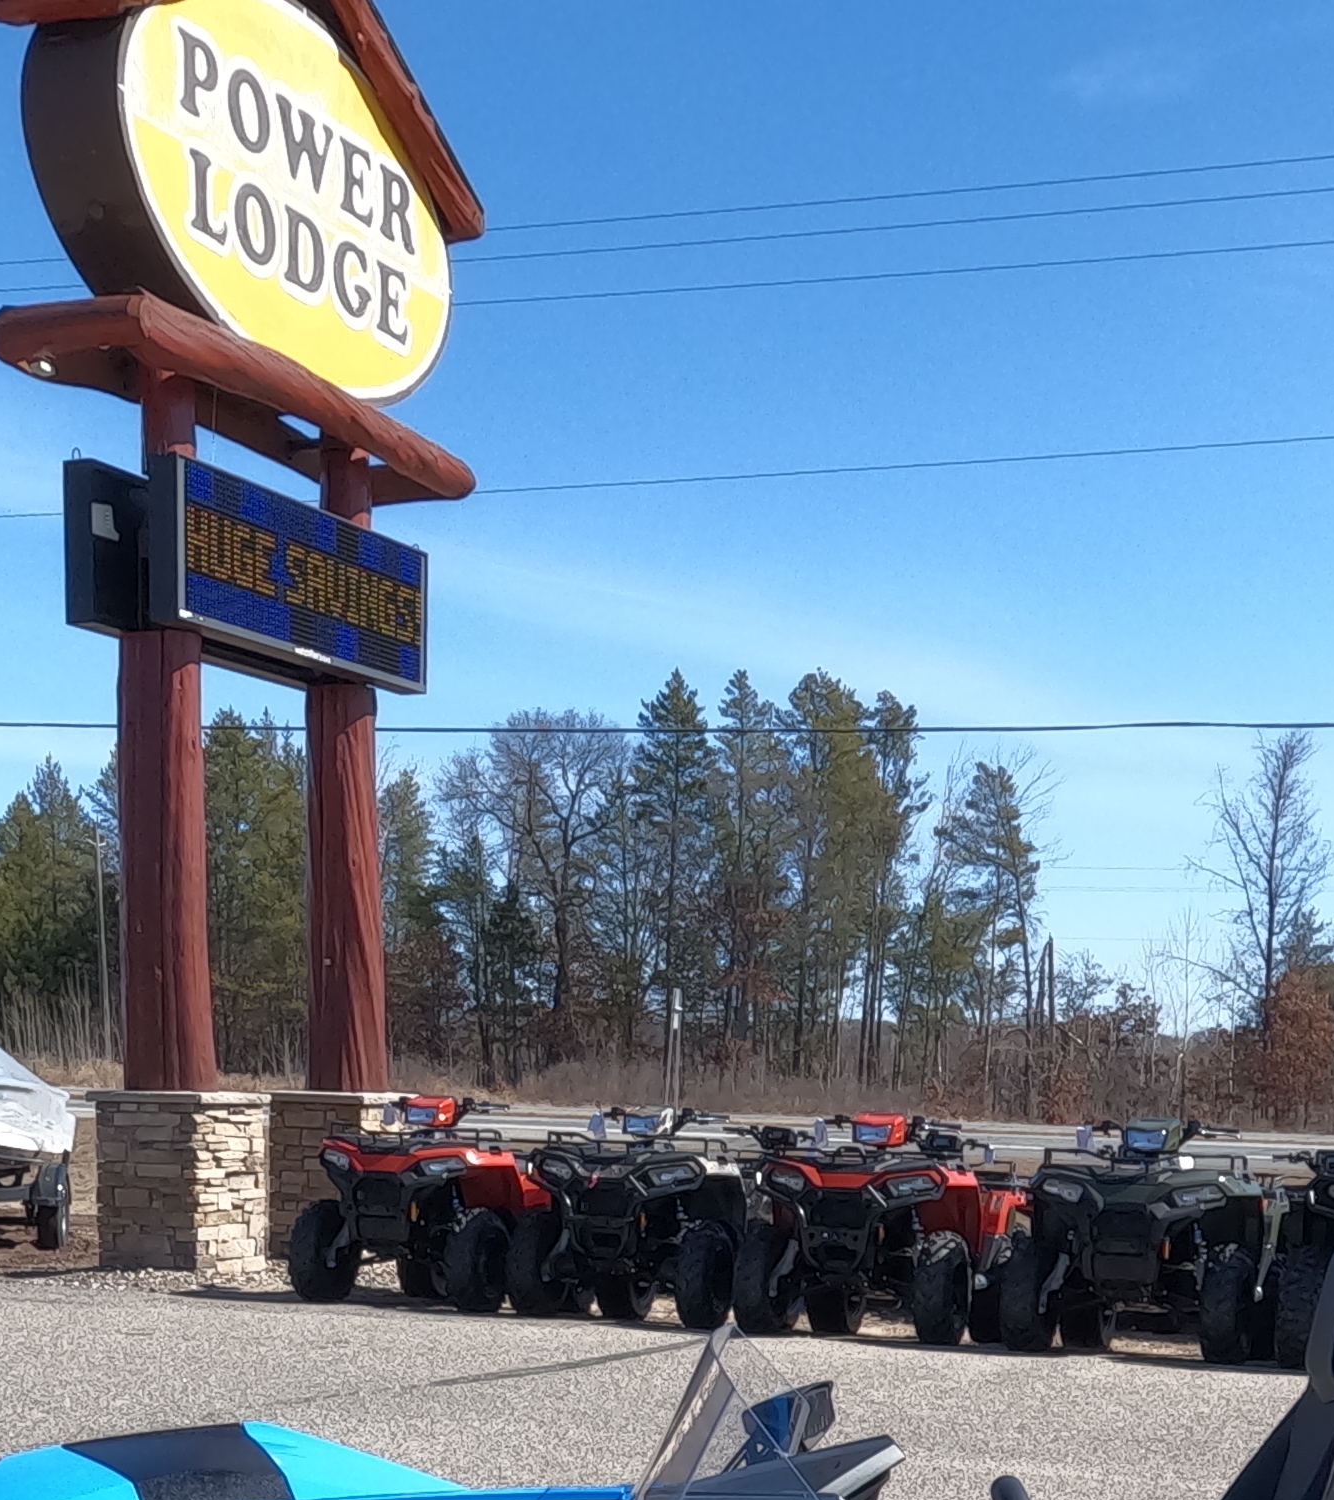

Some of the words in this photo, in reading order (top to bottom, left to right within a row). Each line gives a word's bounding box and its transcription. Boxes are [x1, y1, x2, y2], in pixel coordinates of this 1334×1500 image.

[177, 26, 415, 255] POWER
[189, 147, 408, 346] LODGE
[186, 505, 277, 597] HUGE
